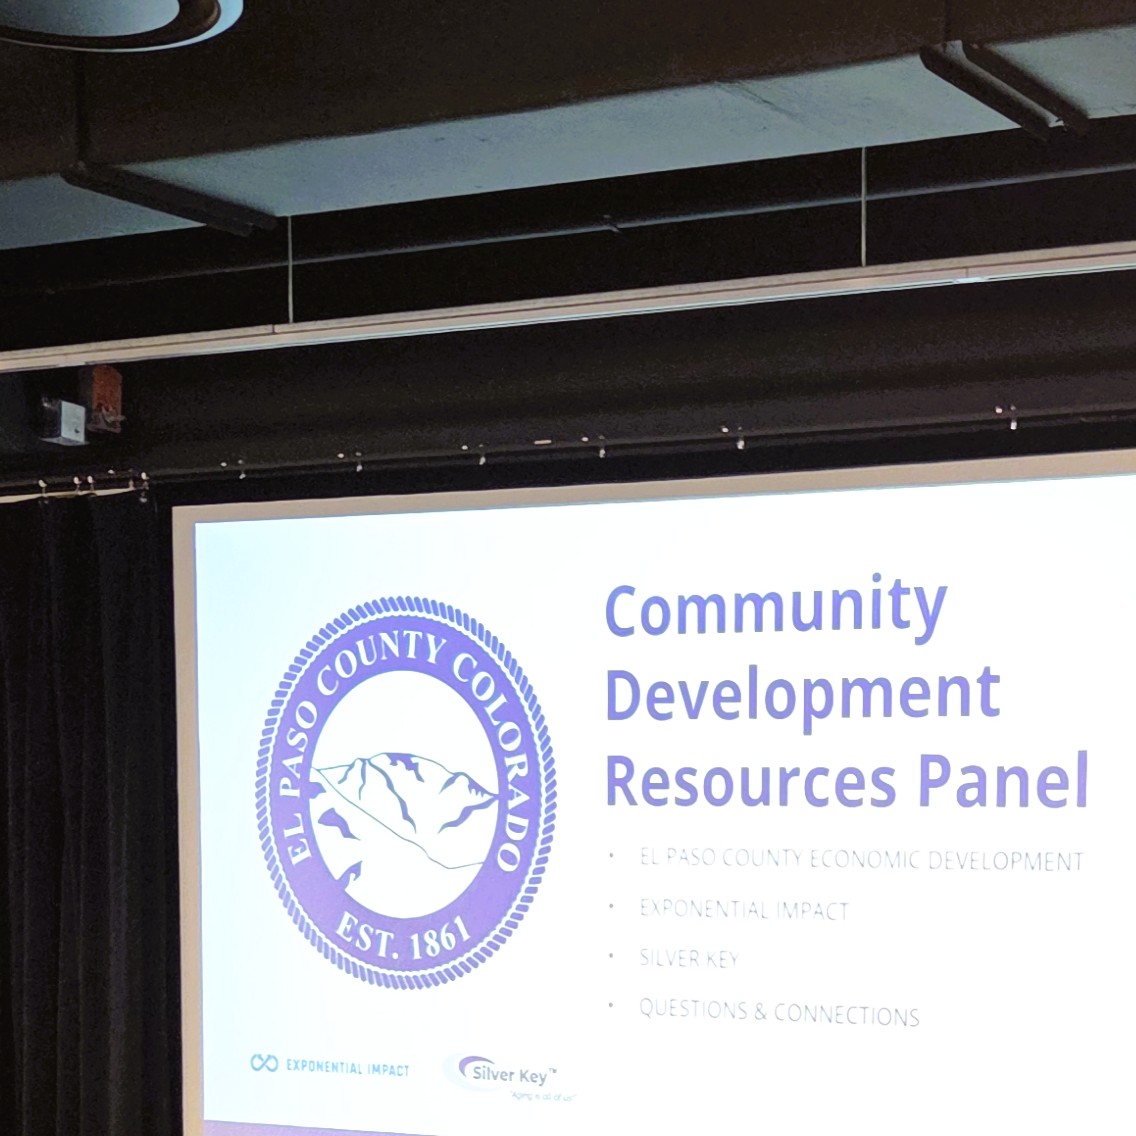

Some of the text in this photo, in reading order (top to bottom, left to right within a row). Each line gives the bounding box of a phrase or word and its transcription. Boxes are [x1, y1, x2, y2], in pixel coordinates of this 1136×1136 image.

[605, 572, 948, 646] Community
[606, 664, 1001, 736] Development
[279, 630, 531, 873] EL PASO COUNTY COLORADO
[606, 750, 1088, 809] Resources Panel
[640, 847, 1085, 872] EL PASO COUNTY ECONOMIC DEVELOPMENT
[640, 898, 850, 921] EXPONENTIAL IMPACT
[336, 910, 472, 961] EST. 1861
[640, 948, 740, 969] SILVER KEY
[639, 997, 921, 1028] QUESTIONS & CONNECTIONS
[286, 1058, 410, 1077] EXPONENTIAL IMPACT
[472, 1065, 515, 1082] Silver
